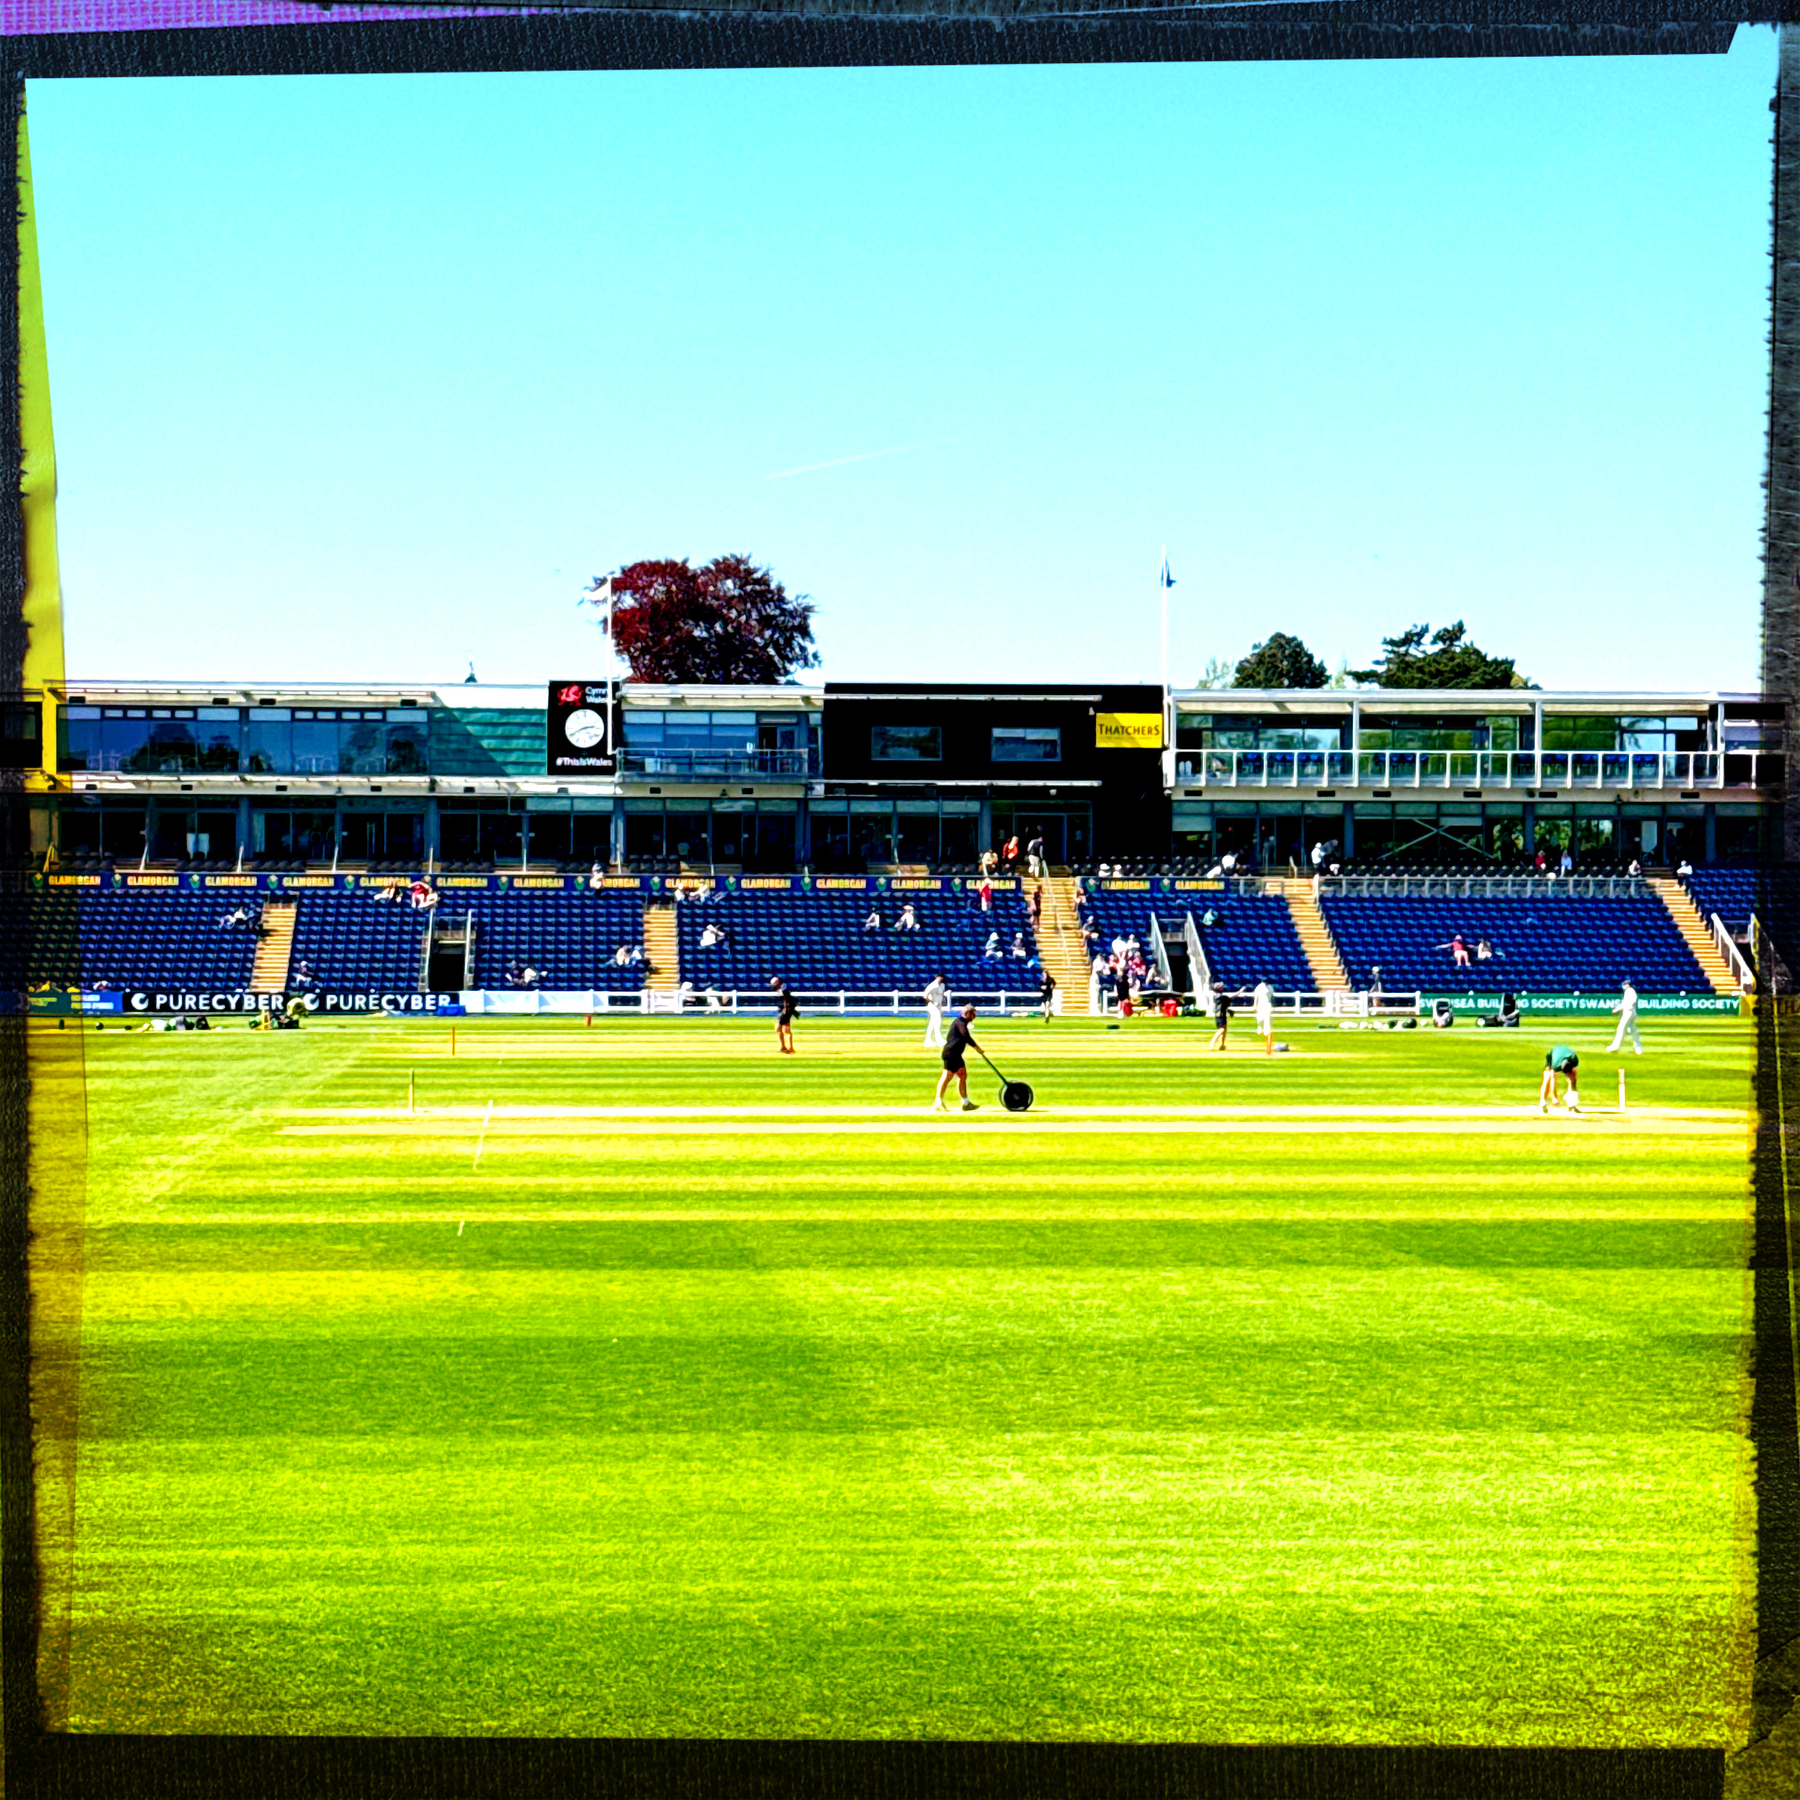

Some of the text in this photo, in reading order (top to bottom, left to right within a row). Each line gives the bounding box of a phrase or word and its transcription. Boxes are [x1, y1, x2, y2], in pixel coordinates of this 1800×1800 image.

[1098, 723, 1160, 736] THATCHERS
[127, 876, 179, 887] GLAMORGAN
[205, 876, 257, 887] GLAMORGAN
[282, 876, 334, 887] GLAMORGAN
[436, 877, 488, 888] GLAMORGAN
[513, 877, 565, 888] GLAMORGAN
[741, 878, 792, 889] GLAMORGAN
[816, 878, 867, 889] GLAMORGAN
[891, 879, 942, 890] GLAMORGAN
[1101, 880, 1150, 891] GLAMORGAN
[1175, 880, 1225, 891] GLAMORGAN
[155, 994, 284, 1010] PURECYBER
[326, 994, 451, 1010] PURECYBER
[1531, 998, 1578, 1009] SOCIETY
[1637, 998, 1690, 1009] BUILDING
[1691, 998, 1740, 1009] SOCIETY
